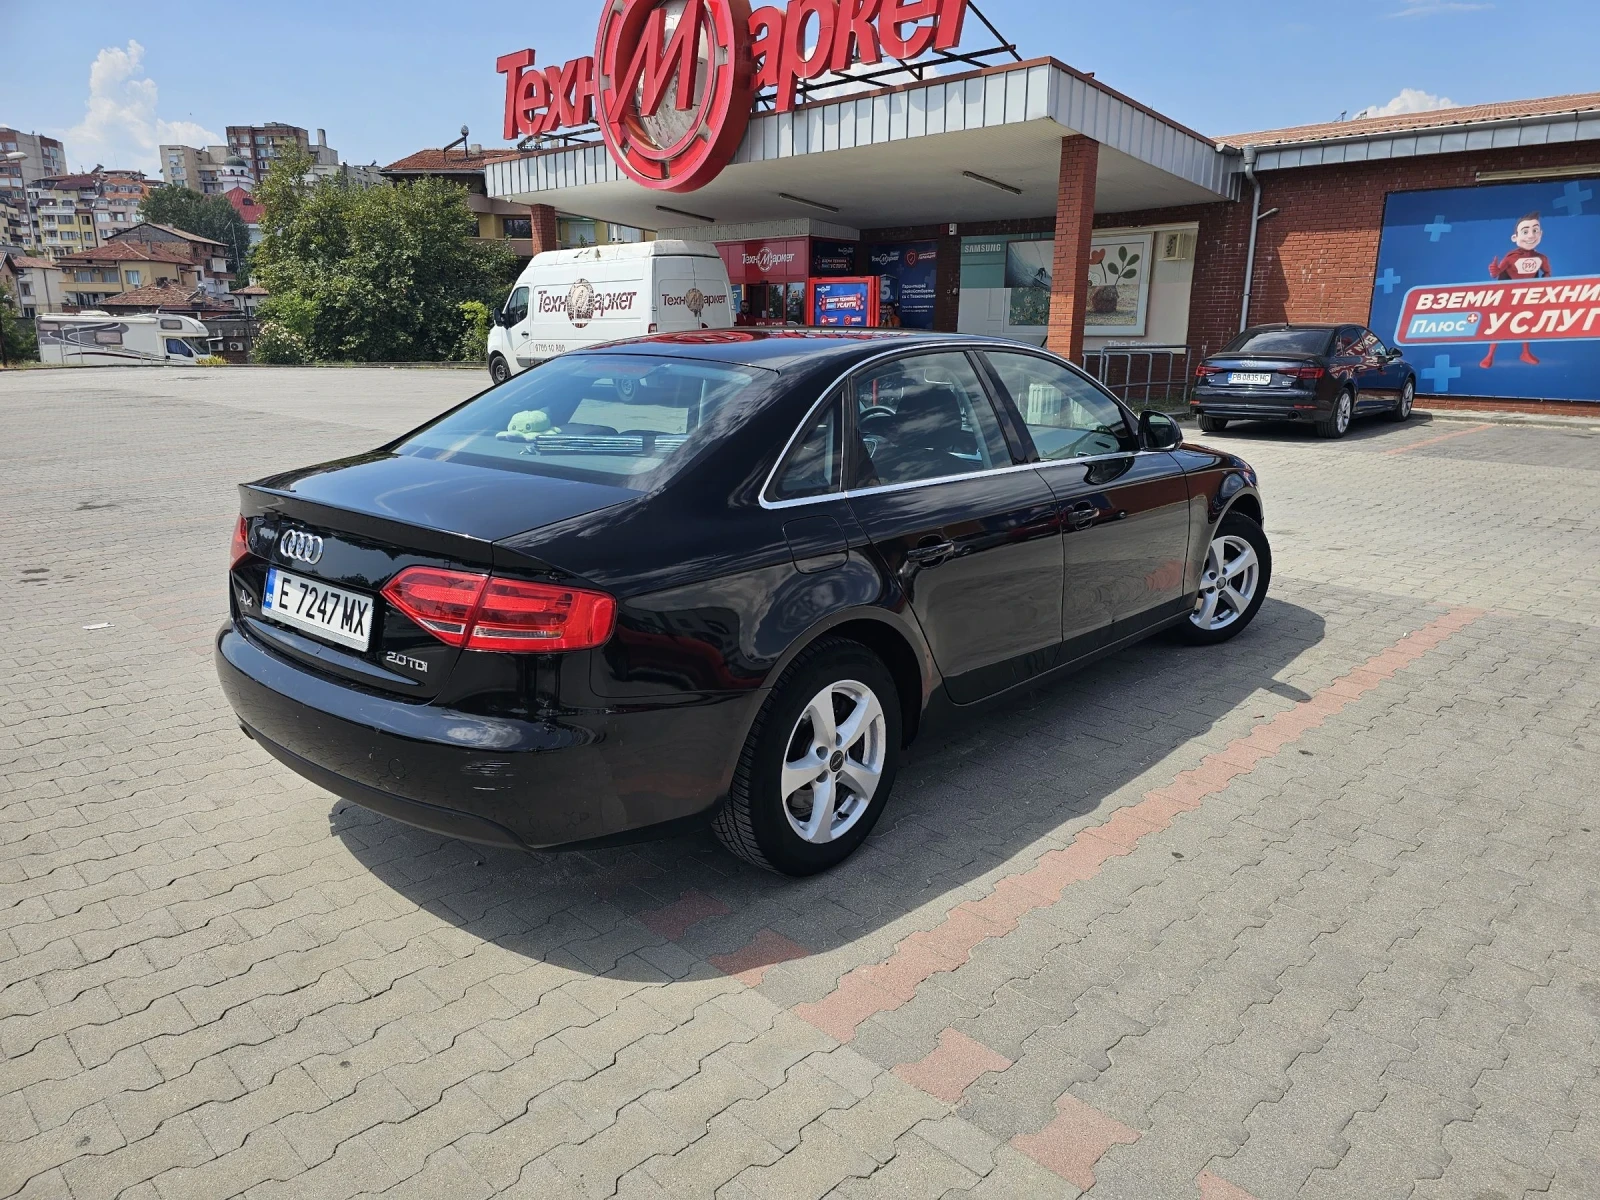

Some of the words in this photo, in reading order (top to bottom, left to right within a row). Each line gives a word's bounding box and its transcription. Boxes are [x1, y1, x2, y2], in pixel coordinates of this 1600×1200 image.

[964, 243, 1001, 253] SAMSUNG
[1415, 289, 1505, 310] ВЗЕМИ
[1510, 283, 1600, 306] ТЕХНИ
[1411, 319, 1467, 334] Плюс
[279, 577, 291, 610] E
[296, 582, 341, 625] 7247
[340, 596, 369, 637] MX
[407, 657, 428, 673] TDI
